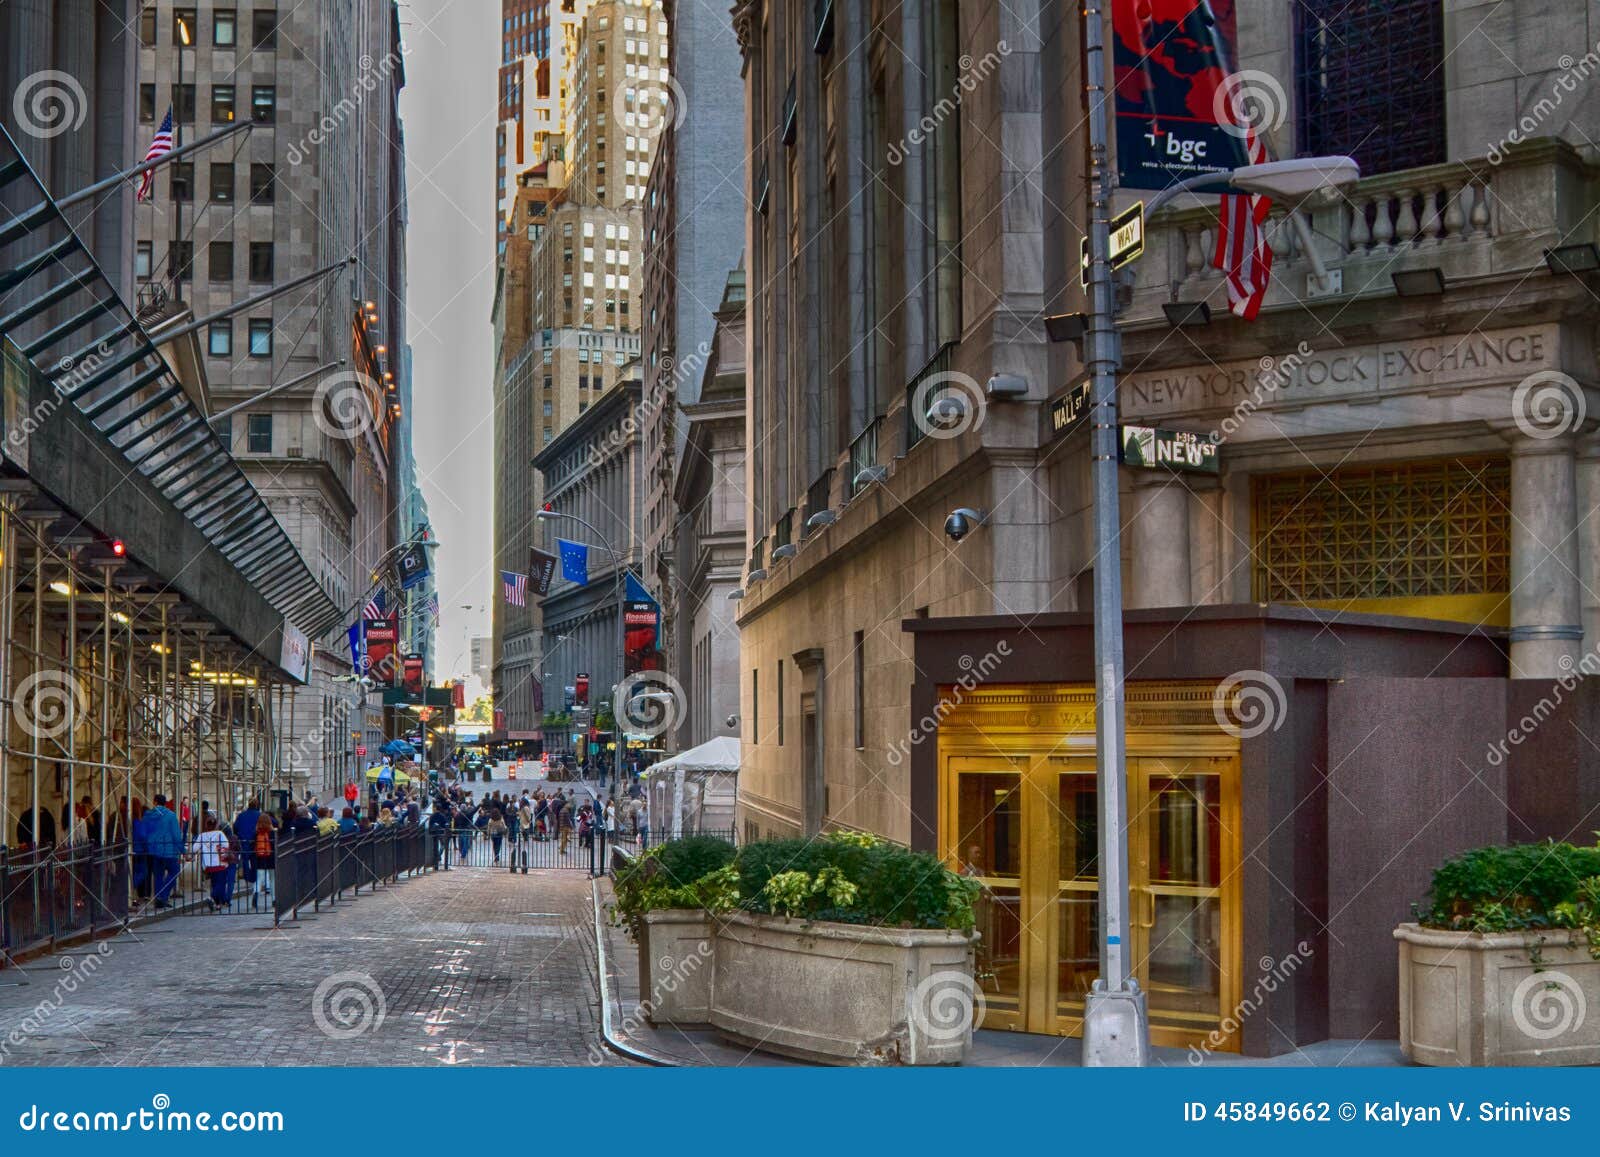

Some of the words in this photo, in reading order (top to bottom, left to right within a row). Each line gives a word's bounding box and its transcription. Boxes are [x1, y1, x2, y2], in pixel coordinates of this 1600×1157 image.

[1166, 132, 1207, 162] bgc
[1116, 222, 1136, 250] WAY
[1131, 375, 1190, 406] NEW
[1197, 367, 1270, 398] YORK
[1277, 355, 1368, 389] STOCK
[1383, 334, 1545, 378] EXCHANGE
[1054, 400, 1077, 430] WALL
[1158, 440, 1202, 464] NEW
[1202, 444, 1217, 457] ST
[625, 612, 657, 621] financial
